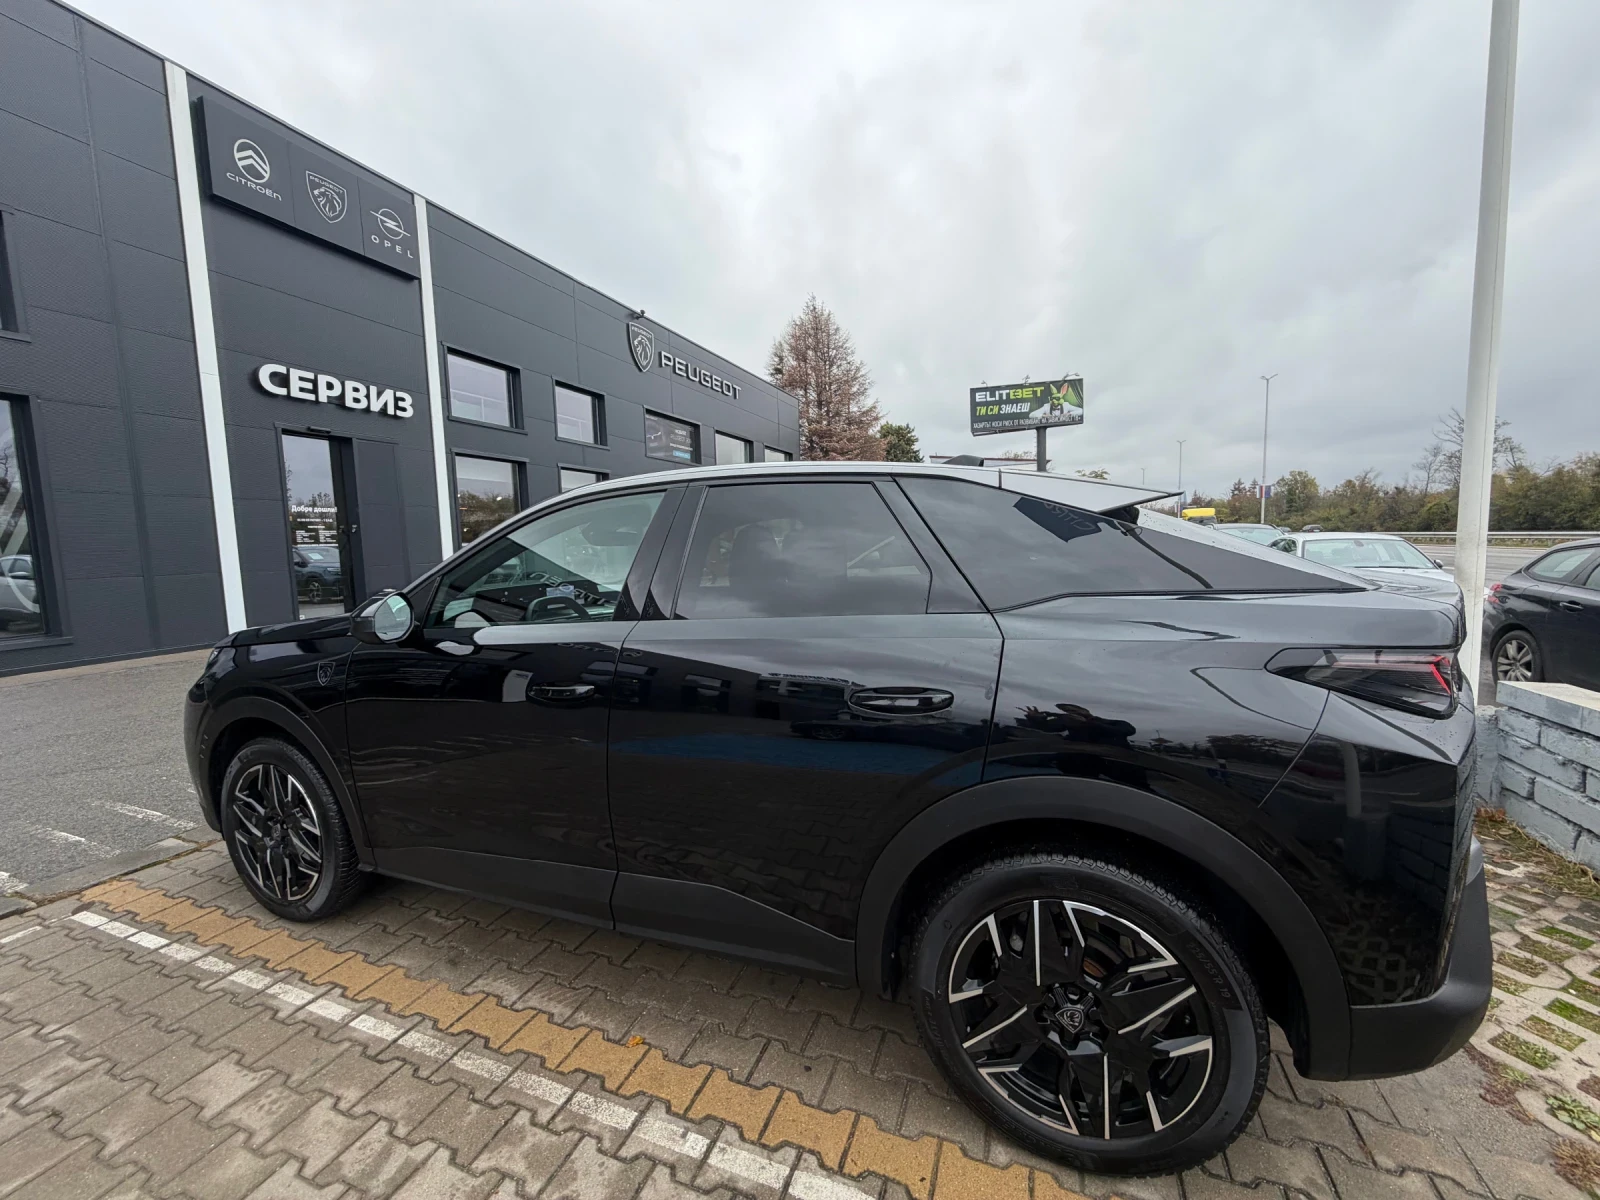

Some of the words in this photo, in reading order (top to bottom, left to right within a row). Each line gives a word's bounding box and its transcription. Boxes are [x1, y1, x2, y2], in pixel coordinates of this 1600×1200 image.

[309, 175, 343, 194] PEUGEOT
[371, 234, 414, 259] OPEL
[631, 326, 652, 339] PEUGEOT
[661, 350, 742, 400] PEUGEOT
[258, 363, 414, 418] СЕРВИЗ
[975, 386, 1045, 402] ELITBET
[976, 406, 987, 416] ТИ
[987, 404, 999, 415] СИ
[999, 402, 1031, 414] ЗНАЕШ
[291, 504, 313, 513] Добре
